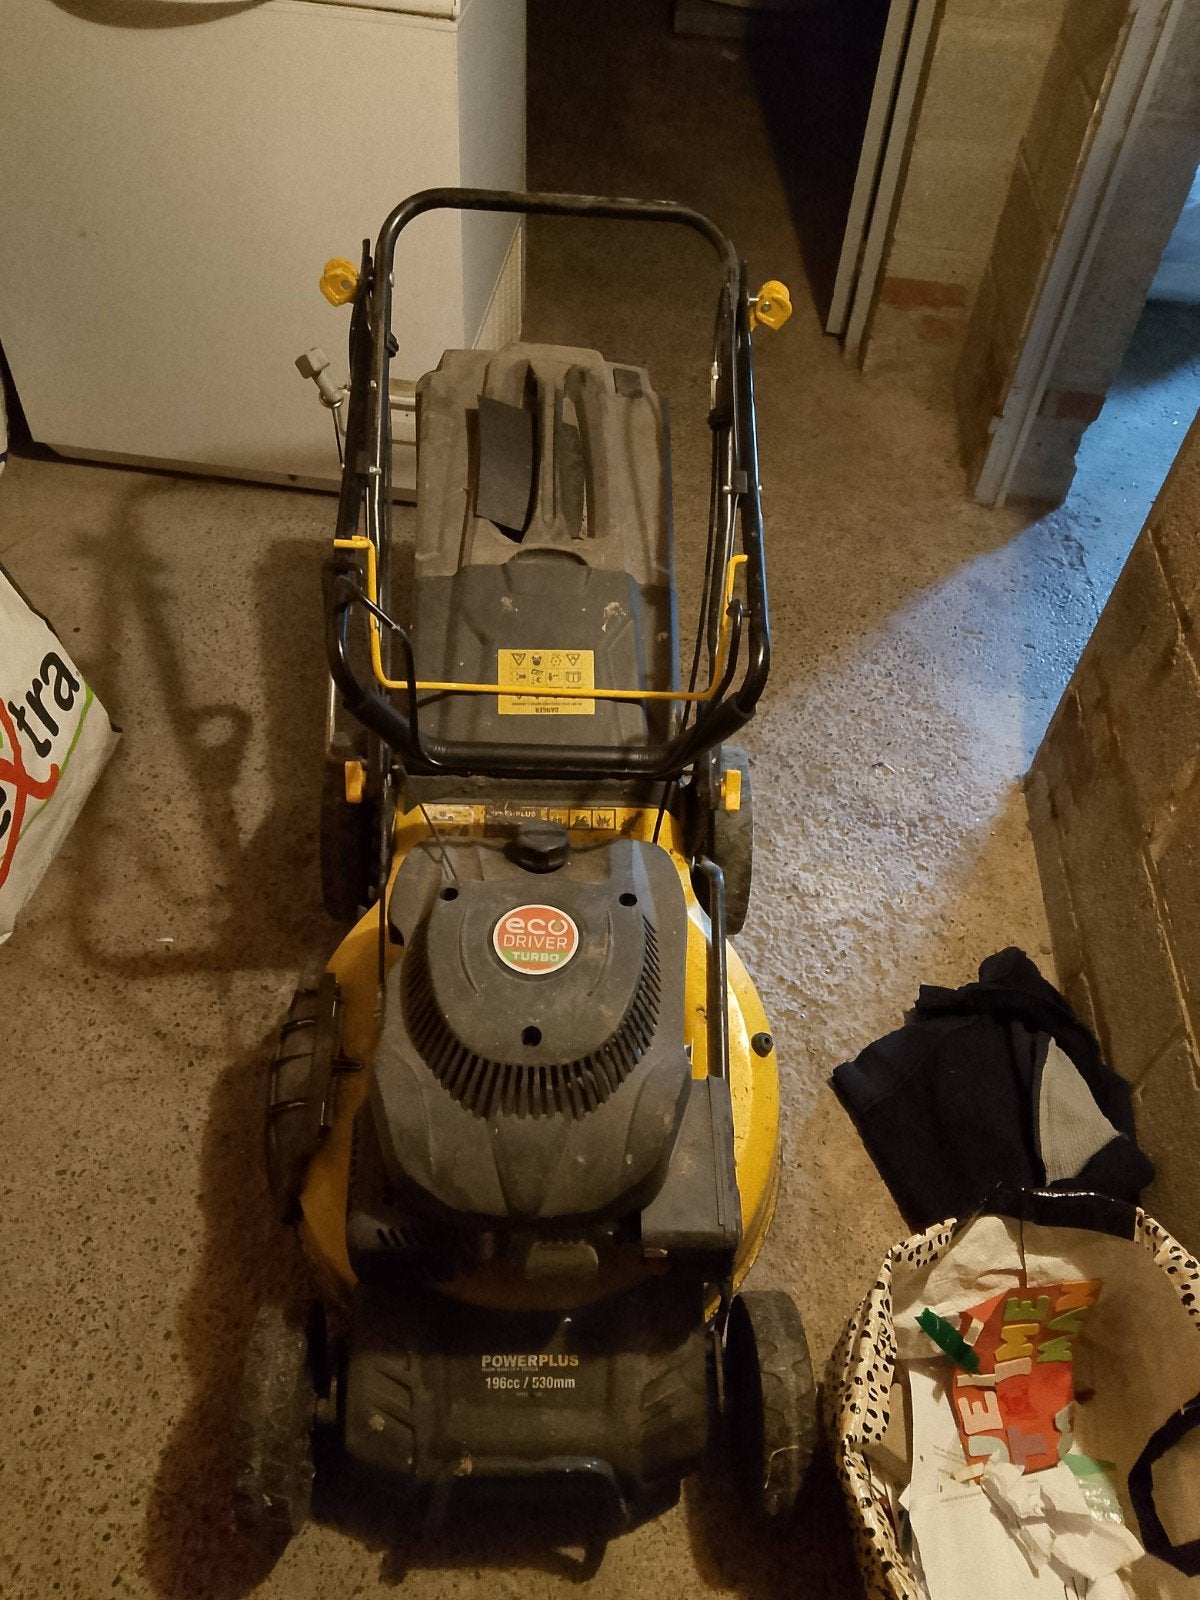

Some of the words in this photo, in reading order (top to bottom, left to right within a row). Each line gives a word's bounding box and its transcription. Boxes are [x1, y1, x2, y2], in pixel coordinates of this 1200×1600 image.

[505, 917, 569, 935] eco
[503, 934, 568, 949] DRIVER
[511, 951, 560, 961] TURBO
[481, 1354, 579, 1367] POWERPLUS
[485, 1376, 520, 1389] 196cc
[523, 1376, 529, 1389] /
[532, 1376, 576, 1389] 530mm
